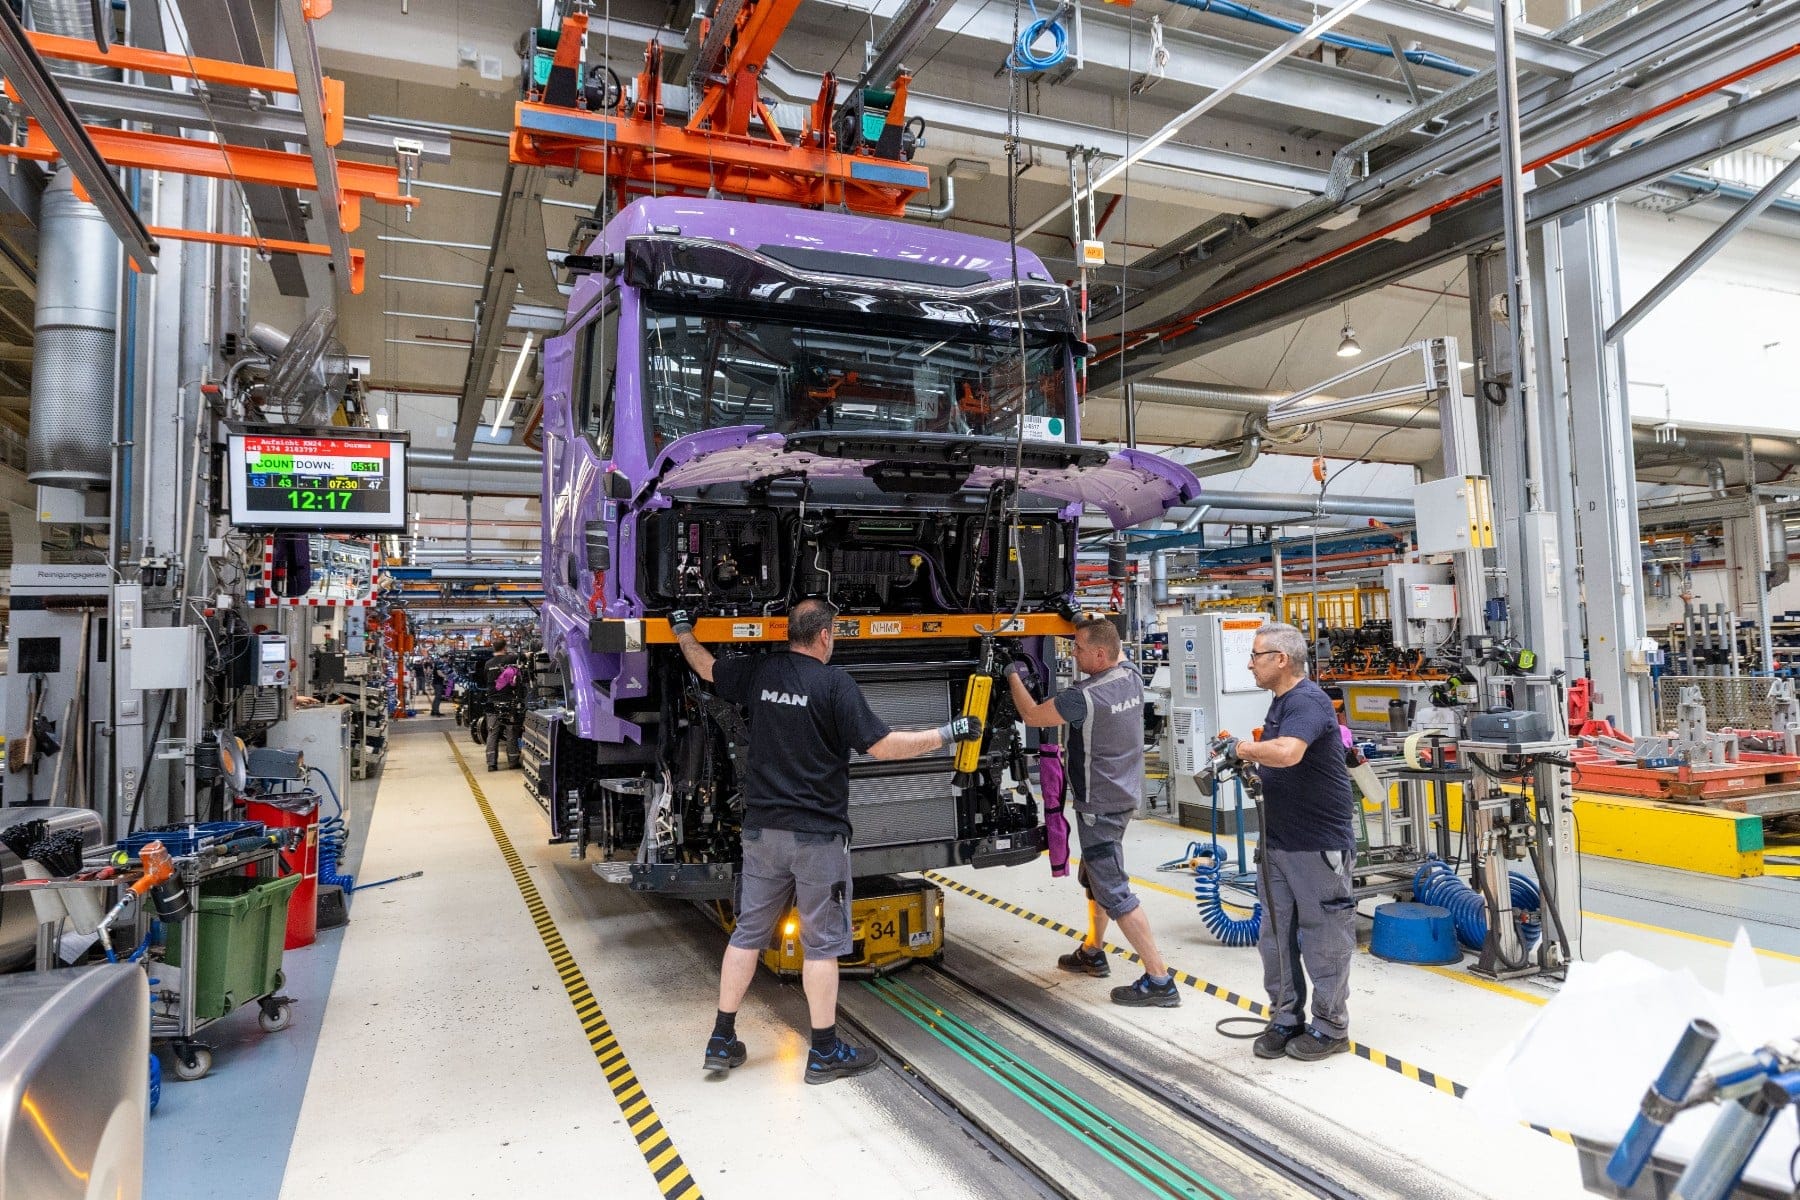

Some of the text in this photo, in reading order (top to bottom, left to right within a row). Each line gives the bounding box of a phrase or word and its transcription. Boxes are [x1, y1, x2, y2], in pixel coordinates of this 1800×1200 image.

[256, 460, 378, 471] COUNTDOWN: 05:11
[252, 479, 266, 487] 63
[278, 479, 292, 488] 43
[329, 480, 358, 489] 07:30
[368, 481, 381, 490] 47
[287, 490, 352, 510] 12:17
[37, 570, 107, 579] Reinigungsgeräte
[761, 689, 808, 707] MAN
[1111, 695, 1141, 714] MAN
[870, 919, 896, 940] 34
